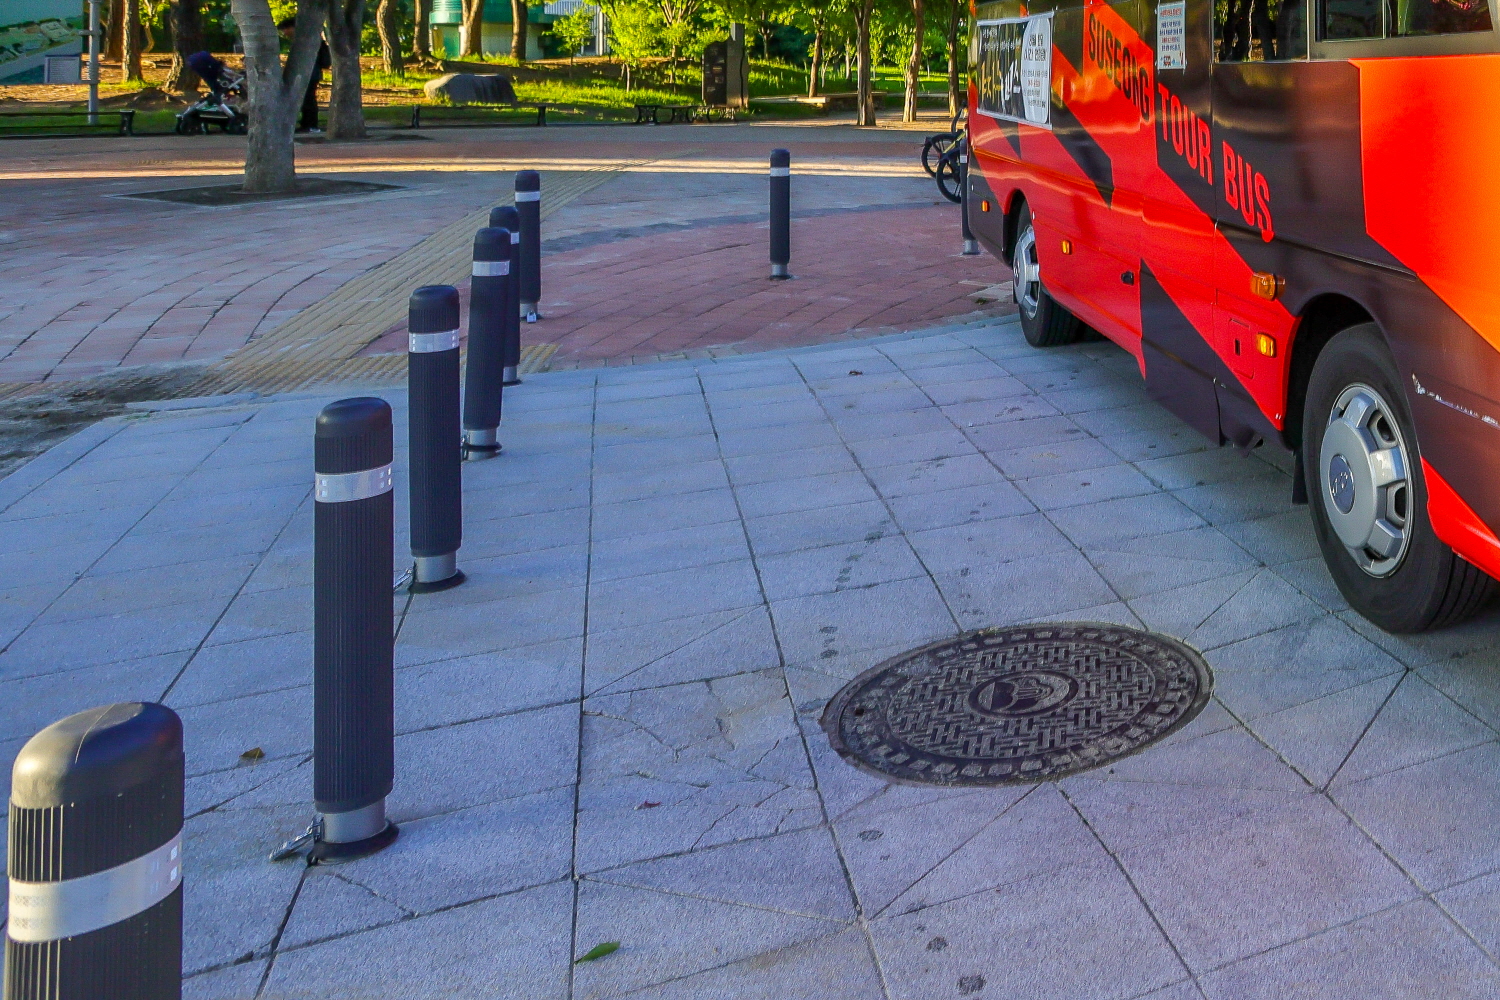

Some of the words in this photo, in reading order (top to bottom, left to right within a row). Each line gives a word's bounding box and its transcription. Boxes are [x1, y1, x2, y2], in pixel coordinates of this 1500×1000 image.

[1087, 11, 1152, 124] SUSEONG
[1158, 82, 1213, 187] TOUR
[1222, 140, 1273, 237] BUS
